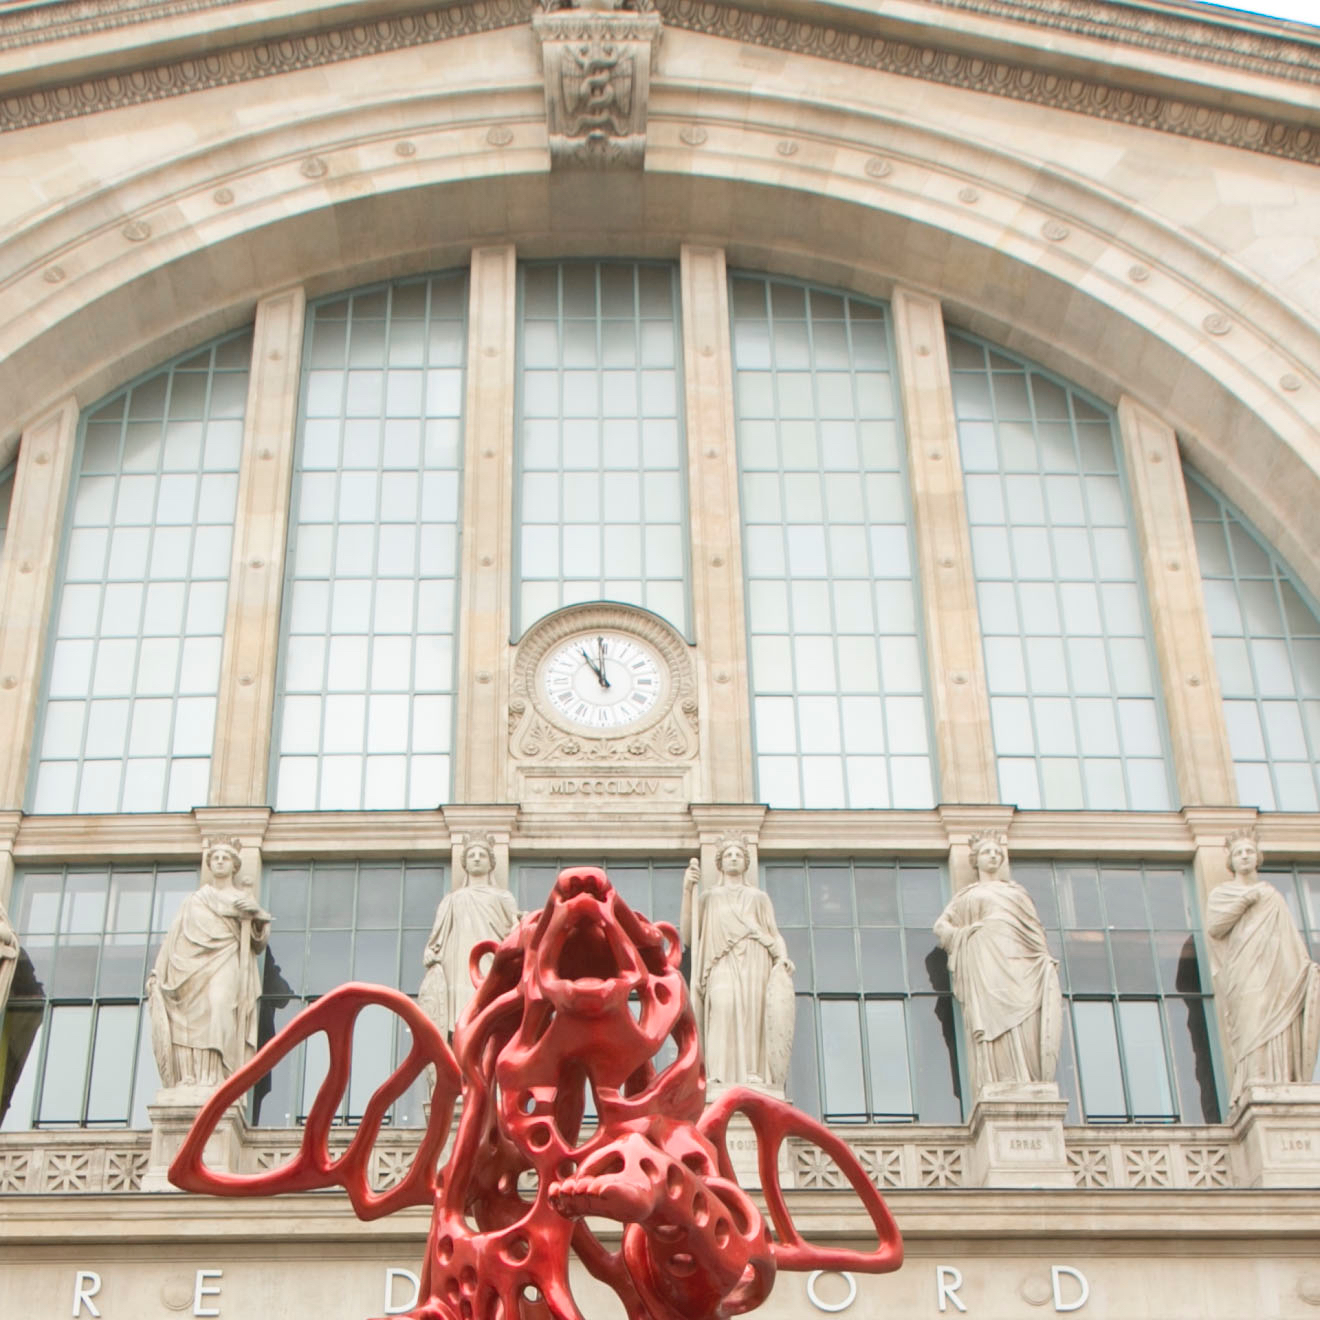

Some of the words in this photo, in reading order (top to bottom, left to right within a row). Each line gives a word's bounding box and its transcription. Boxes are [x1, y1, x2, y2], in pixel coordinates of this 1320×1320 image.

[549, 780, 660, 796] MDCCCLXIV
[1010, 1139, 1042, 1150] ARRAS
[1281, 1139, 1312, 1151] LAON
[806, 1265, 1090, 1313] ORD
